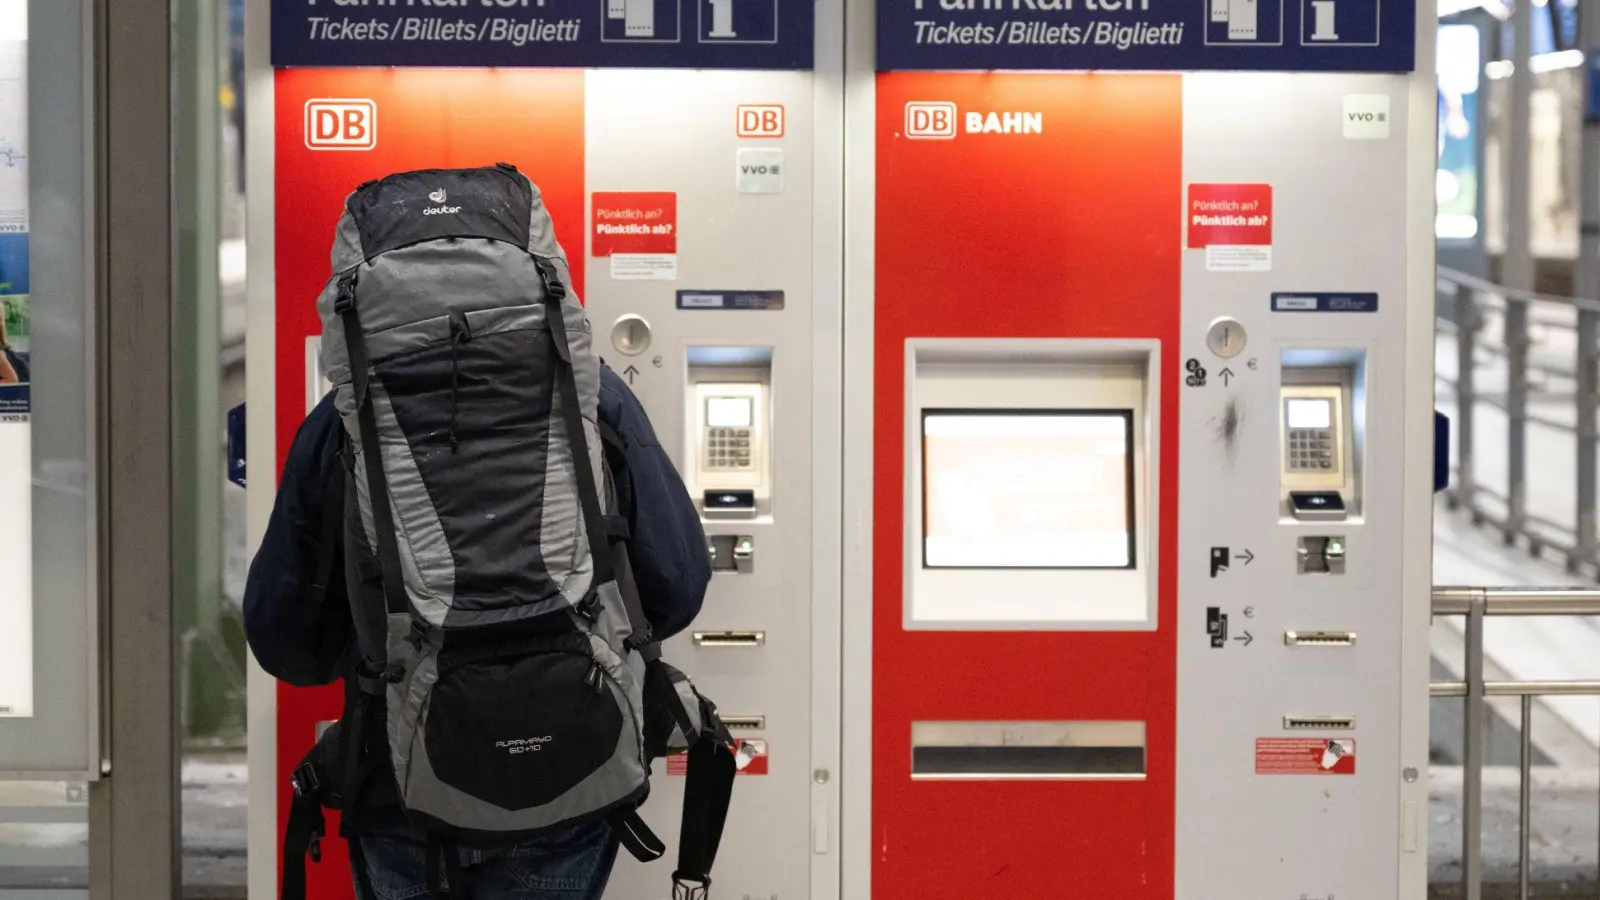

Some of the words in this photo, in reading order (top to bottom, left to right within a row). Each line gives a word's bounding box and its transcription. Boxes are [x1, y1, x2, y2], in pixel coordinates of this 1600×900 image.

[743, 110, 778, 131] DB
[965, 111, 1043, 134] BAHN
[1348, 112, 1374, 122] VVO
[741, 165, 767, 174] VVO
[422, 205, 462, 216] deuter
[1193, 200, 1239, 211] Pünktlich
[1240, 200, 1259, 211] an?
[596, 208, 643, 219] Pünktlich
[644, 208, 663, 219] an?
[1192, 215, 1246, 226] Pünktlich
[1247, 215, 1268, 226] ab?
[596, 223, 650, 235] Pünktlich
[651, 223, 672, 234] ab?
[652, 355, 663, 368] €
[1246, 357, 1258, 370] €
[1243, 606, 1255, 619] €
[495, 735, 552, 748] ALPAMAYO
[509, 744, 541, 755] 60+10
